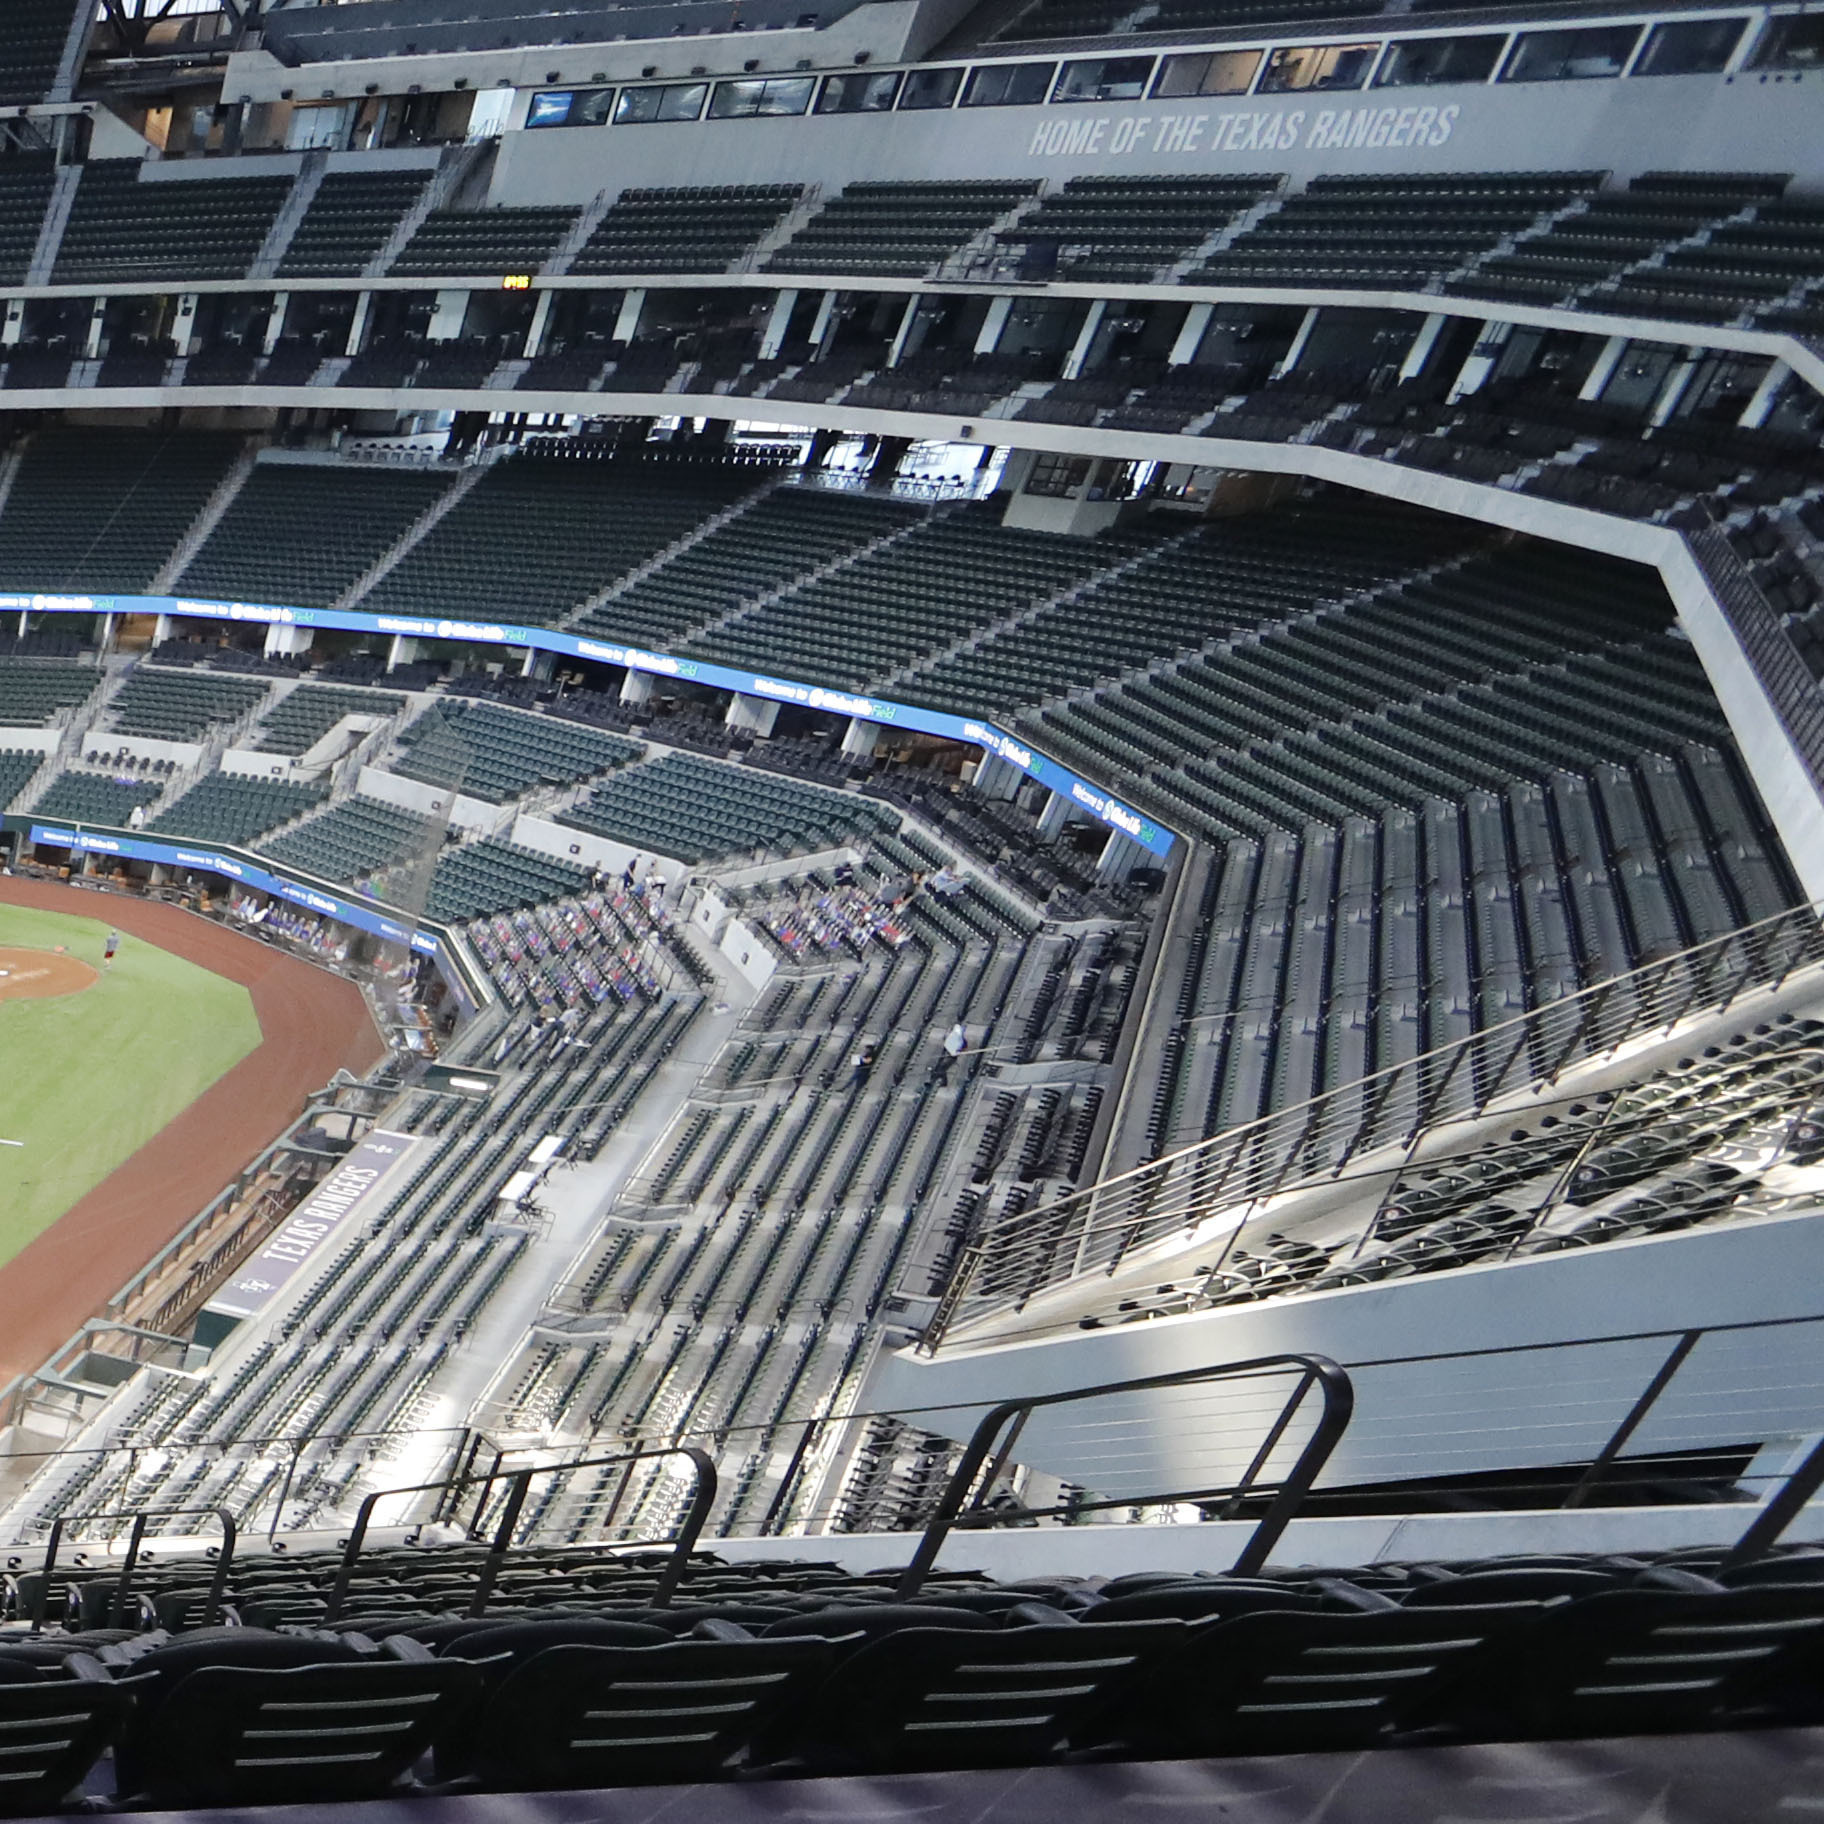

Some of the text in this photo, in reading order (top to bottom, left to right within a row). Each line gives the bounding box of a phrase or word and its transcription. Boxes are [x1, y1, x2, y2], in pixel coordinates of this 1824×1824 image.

[1029, 104, 1460, 156] HOME OF THE TEXAS RANGERS
[263, 1165, 378, 1263] TEXAS RANGERS
